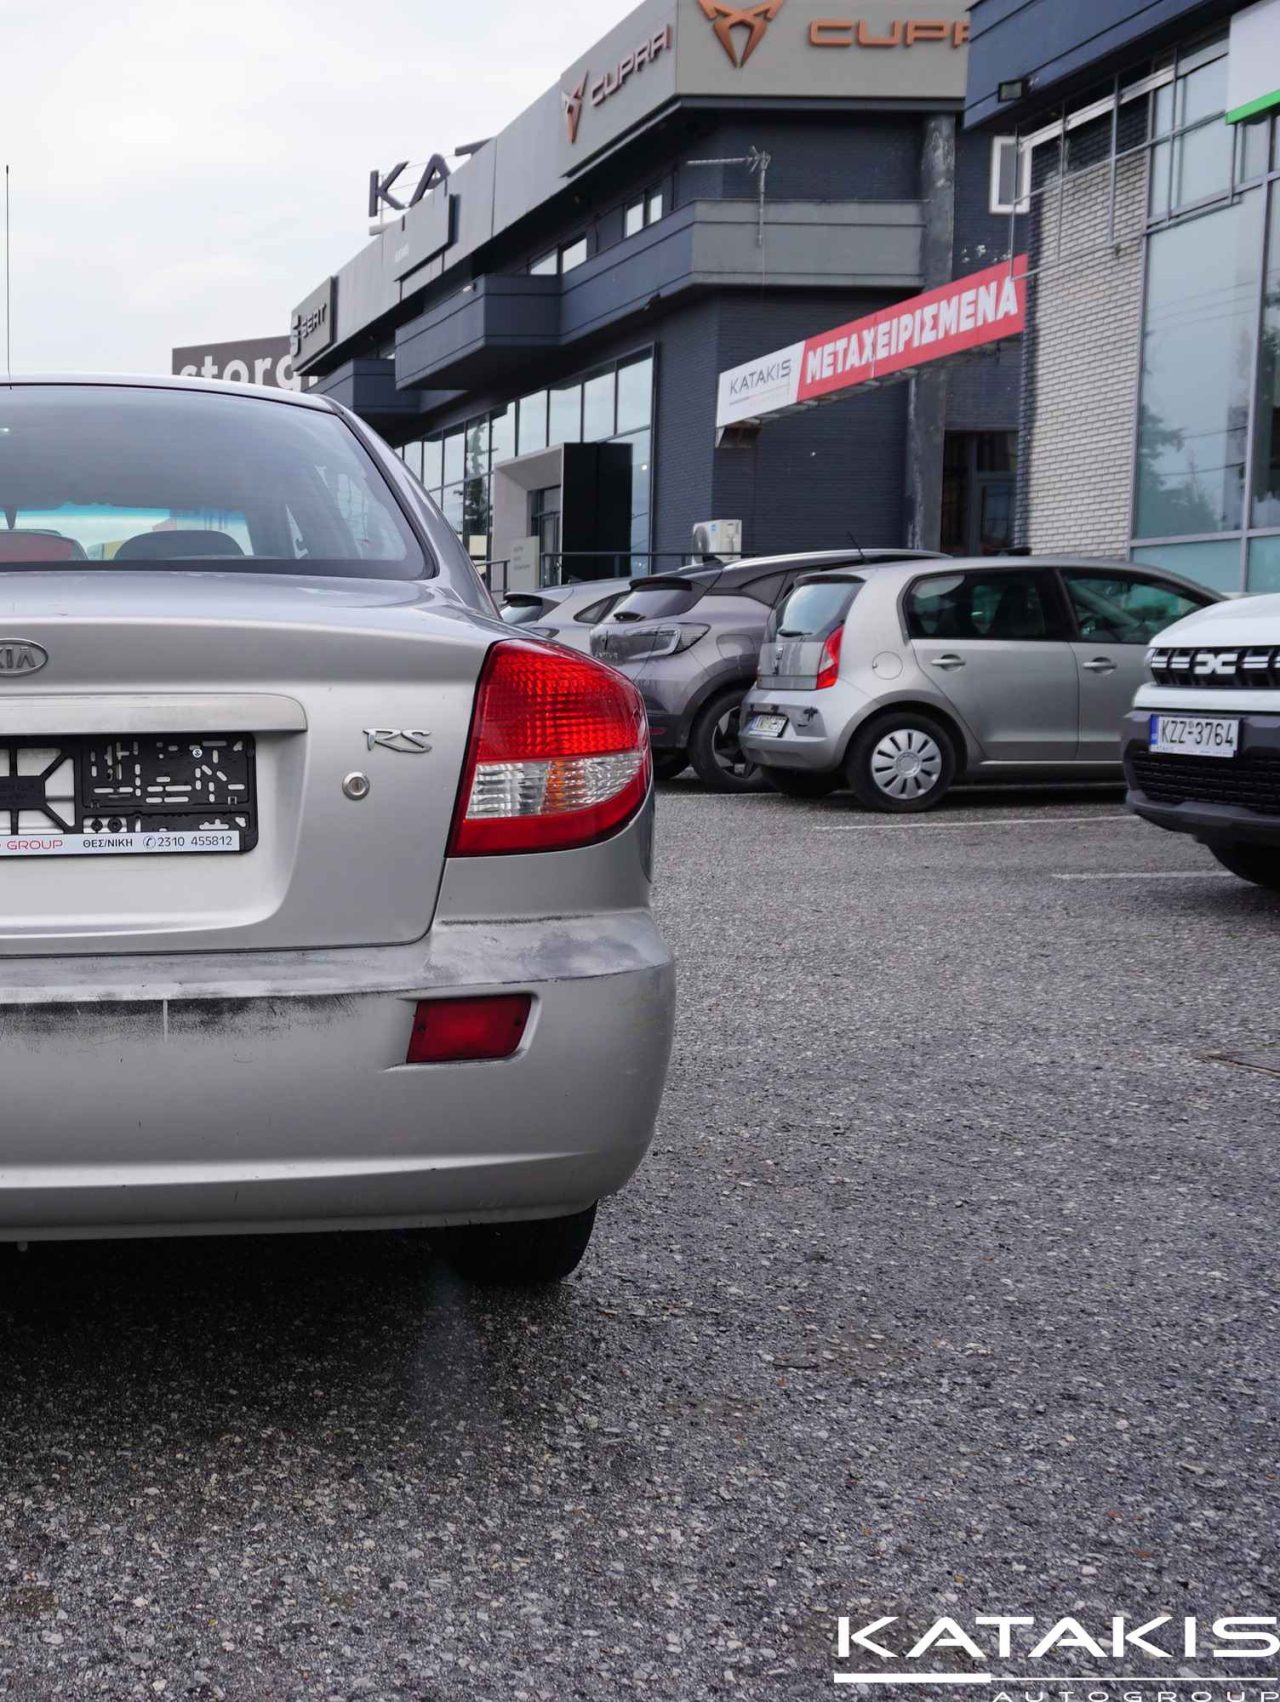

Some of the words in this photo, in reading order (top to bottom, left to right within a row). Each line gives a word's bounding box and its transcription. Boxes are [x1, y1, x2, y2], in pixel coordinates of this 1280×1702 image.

[592, 24, 672, 107] CUPRA
[301, 303, 327, 338] SEAT
[806, 276, 1018, 384] ΜΕΤΑΧΕΙΡΙΣΜΕΝΑ
[730, 358, 792, 396] KATAKIS
[362, 728, 432, 754] RS
[6, 839, 64, 851] GROUP
[82, 837, 133, 848] ΘΕΣ/ΝΙΚΗ
[157, 836, 185, 848] 2310
[191, 835, 233, 847] 455812
